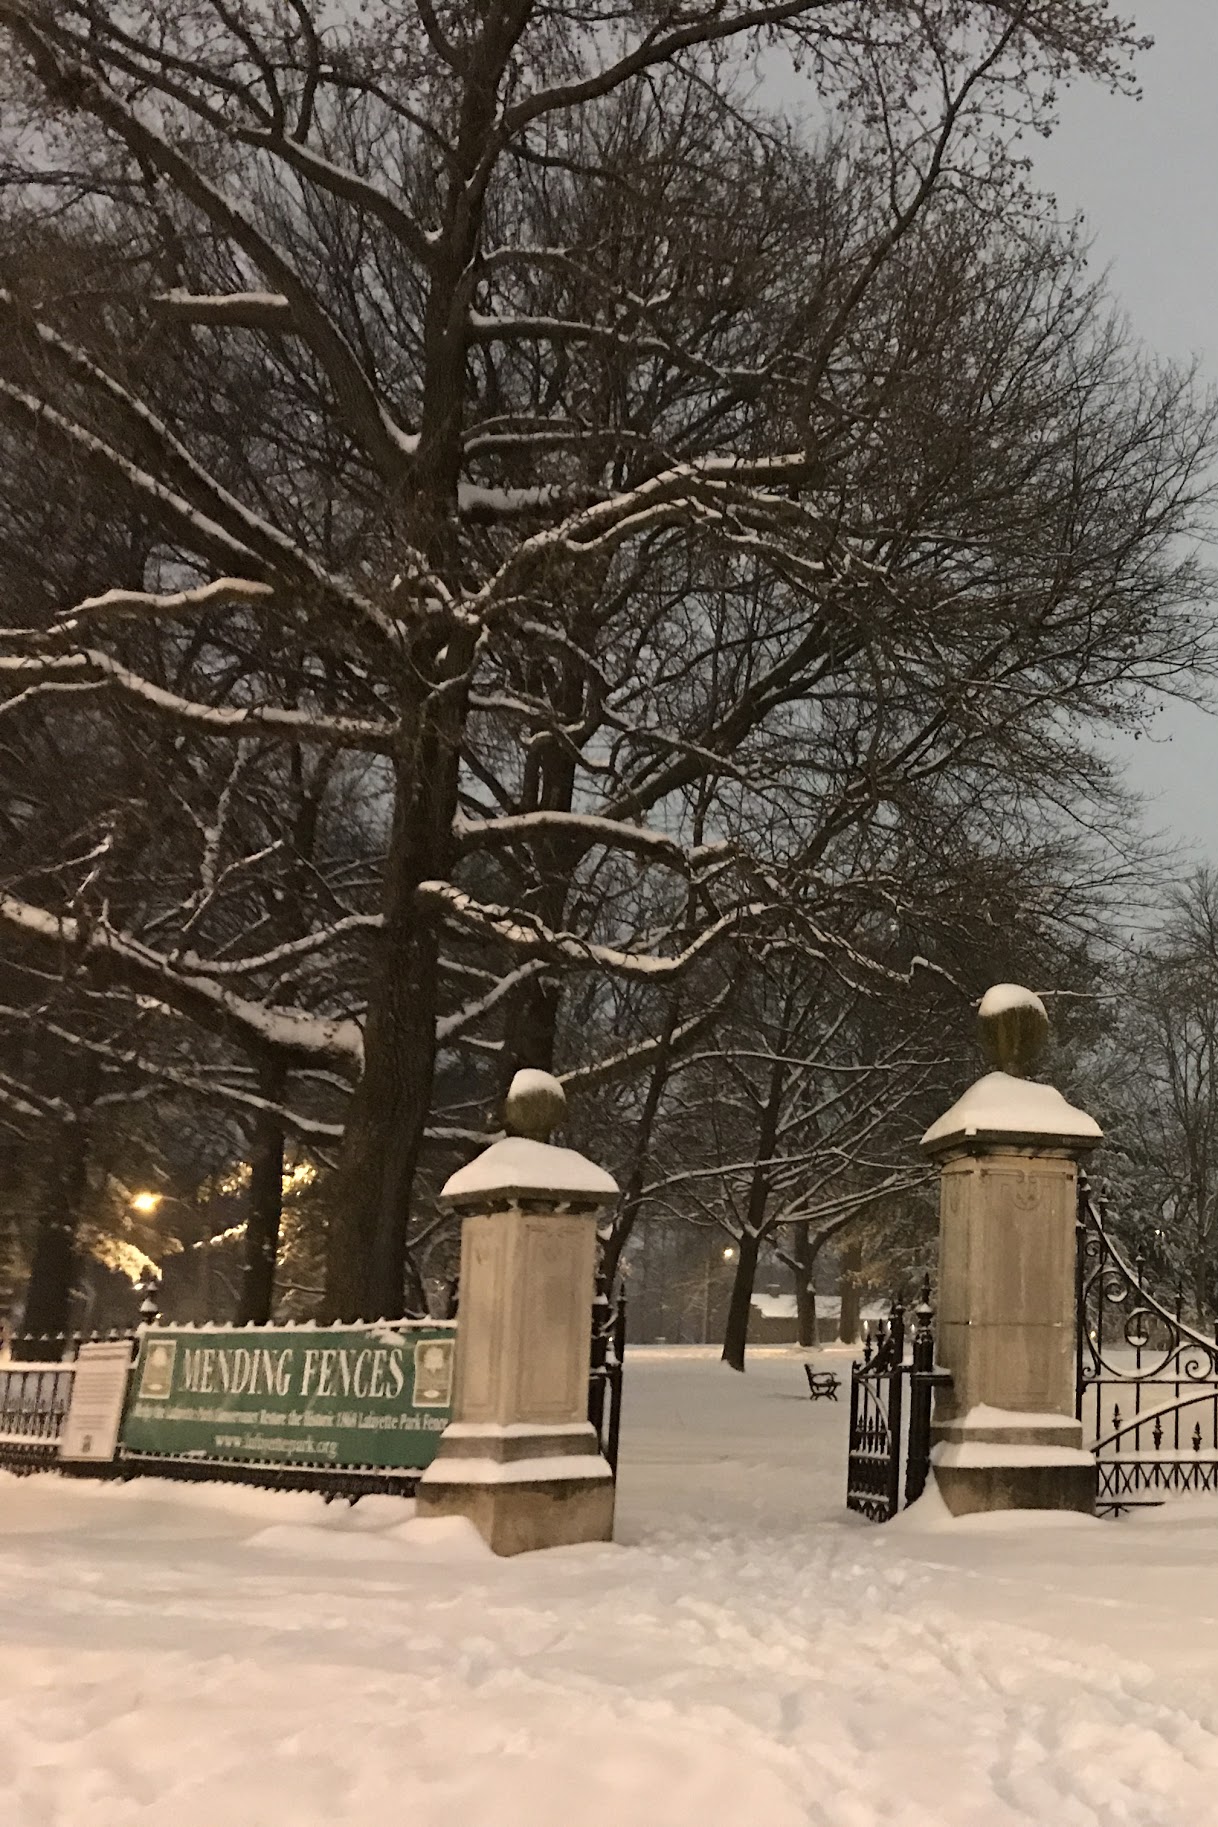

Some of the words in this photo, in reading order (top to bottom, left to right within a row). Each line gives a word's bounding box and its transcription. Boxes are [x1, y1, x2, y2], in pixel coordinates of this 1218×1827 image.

[178, 1348, 293, 1396] MENDING
[300, 1348, 404, 1399] FENCES
[399, 1413, 421, 1430] Park
